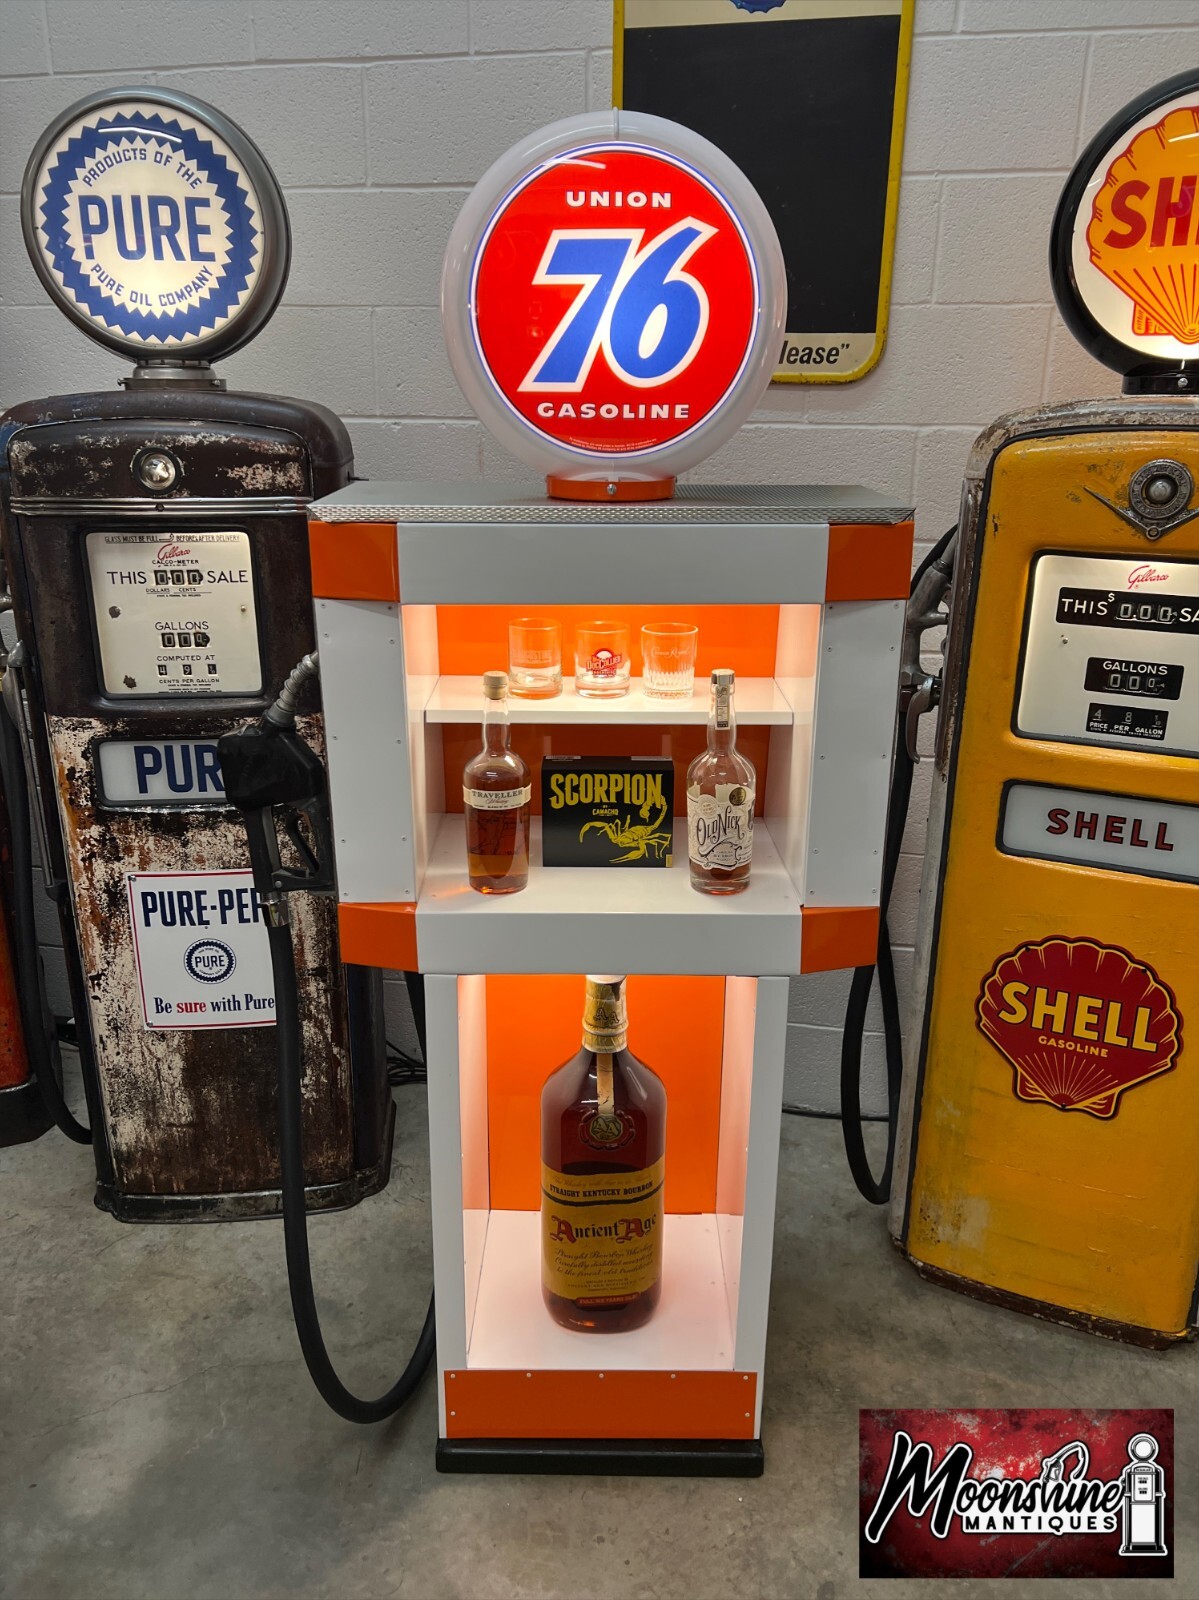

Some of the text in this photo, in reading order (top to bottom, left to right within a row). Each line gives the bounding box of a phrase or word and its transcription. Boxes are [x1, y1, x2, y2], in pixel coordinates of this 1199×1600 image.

[82, 147, 202, 190] PRODUCTS OF THE
[566, 191, 672, 208] UNION
[1103, 175, 1199, 249] SH
[78, 194, 216, 262] PURE
[90, 263, 213, 307] PURE OIL COMPANY
[516, 216, 719, 393] 76
[537, 402, 690, 420] GASOLINE
[106, 571, 147, 584] THIS
[207, 570, 248, 583] SALE
[1128, 565, 1169, 589] Gilbarco
[1061, 598, 1108, 616] THIS
[1107, 592, 1115, 602] $
[155, 621, 209, 630] GALLONS
[1103, 661, 1168, 675] GALLONS
[1135, 727, 1163, 735] GALLON
[472, 790, 523, 798] TRAVELLER
[549, 773, 663, 809] SCORPION
[1046, 808, 1174, 851] SHELL
[195, 955, 225, 968] PURE
[154, 993, 275, 1013] Be sure with Pure
[998, 981, 1158, 1053] SHELL
[1038, 1035, 1109, 1058] GASOLINE
[549, 1184, 580, 1197] STRAIGHT
[583, 1188, 620, 1197] KENTUCKY
[623, 1181, 653, 1195] BOURBON
[550, 1214, 657, 1243] Ancient Age
